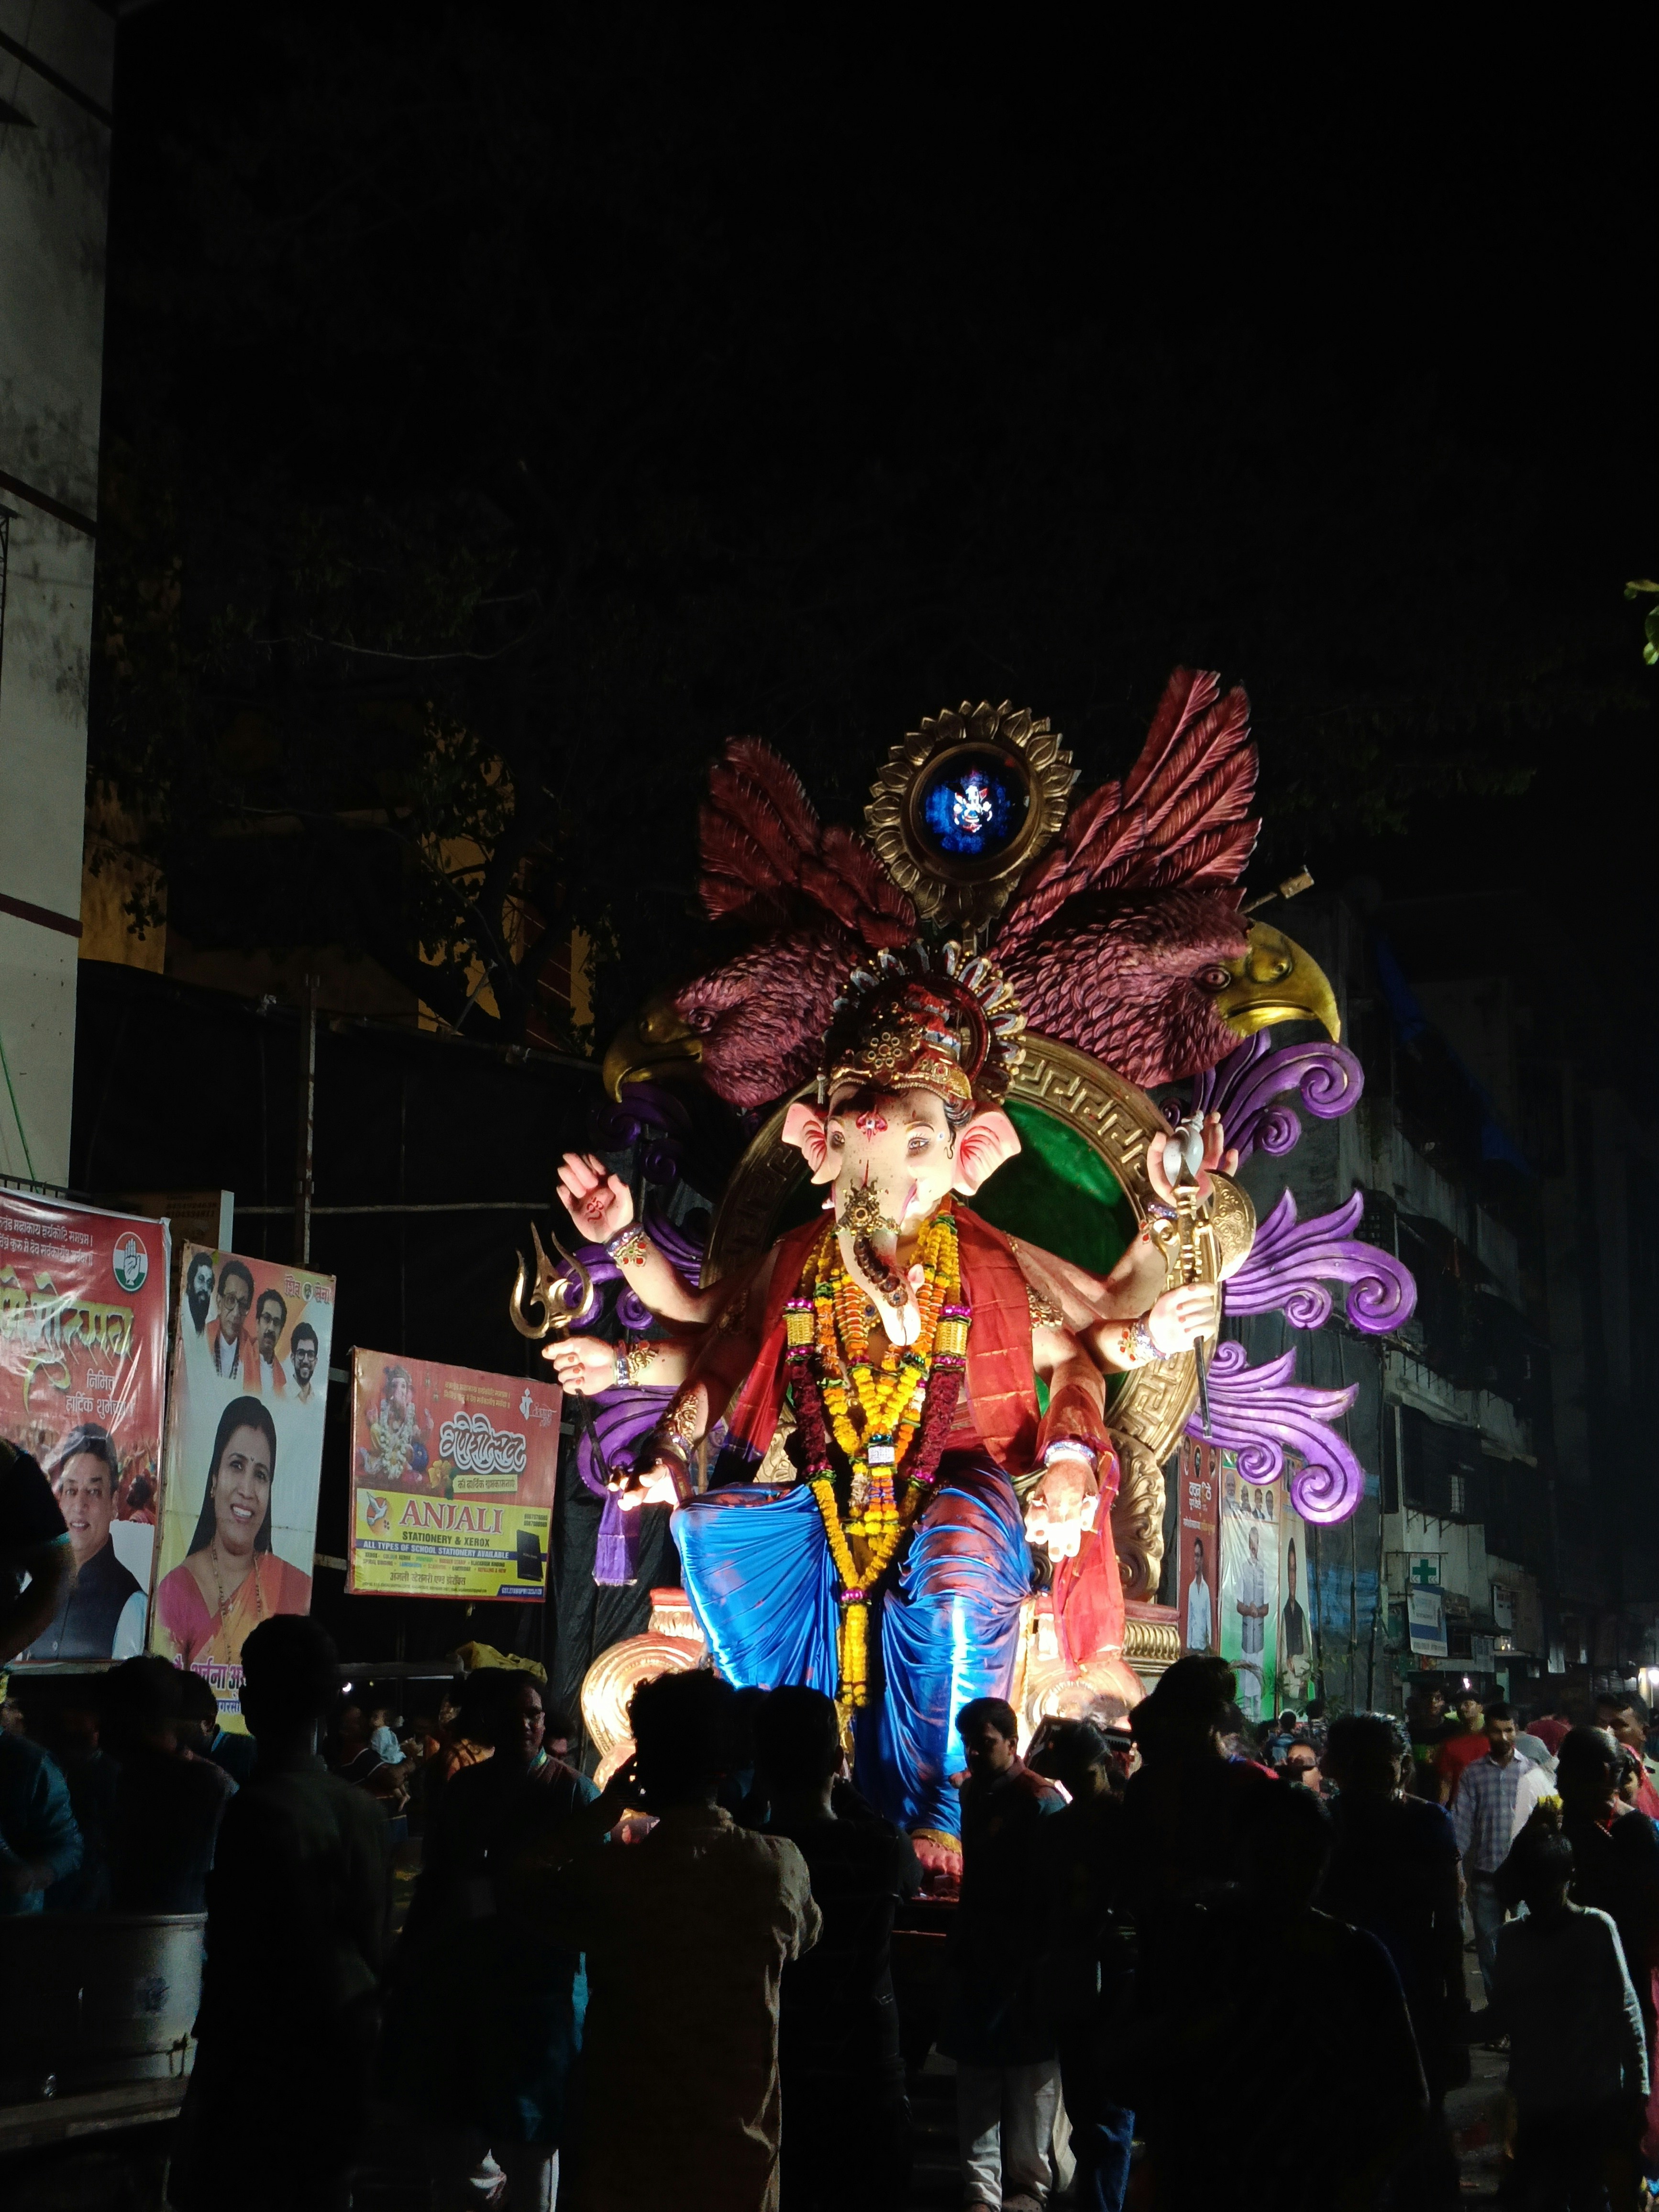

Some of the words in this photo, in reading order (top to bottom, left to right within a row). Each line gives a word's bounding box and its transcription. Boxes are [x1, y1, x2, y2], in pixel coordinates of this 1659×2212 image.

[65, 1391, 94, 1413] हार्दिक
[440, 1411, 527, 1474] गणेशोत्सव
[399, 1499, 504, 1534] ANJALI
[402, 1531, 452, 1544] STATIONERY
[455, 1536, 461, 1545] &
[464, 1537, 490, 1547] XEROX
[363, 1540, 376, 1548] ALL
[378, 1541, 398, 1551] TYPES
[411, 1545, 436, 1554] SCHOOL
[438, 1547, 476, 1557] STATIONERY
[477, 1550, 509, 1559] AVAILABLE
[390, 1569, 409, 1582] अंजली
